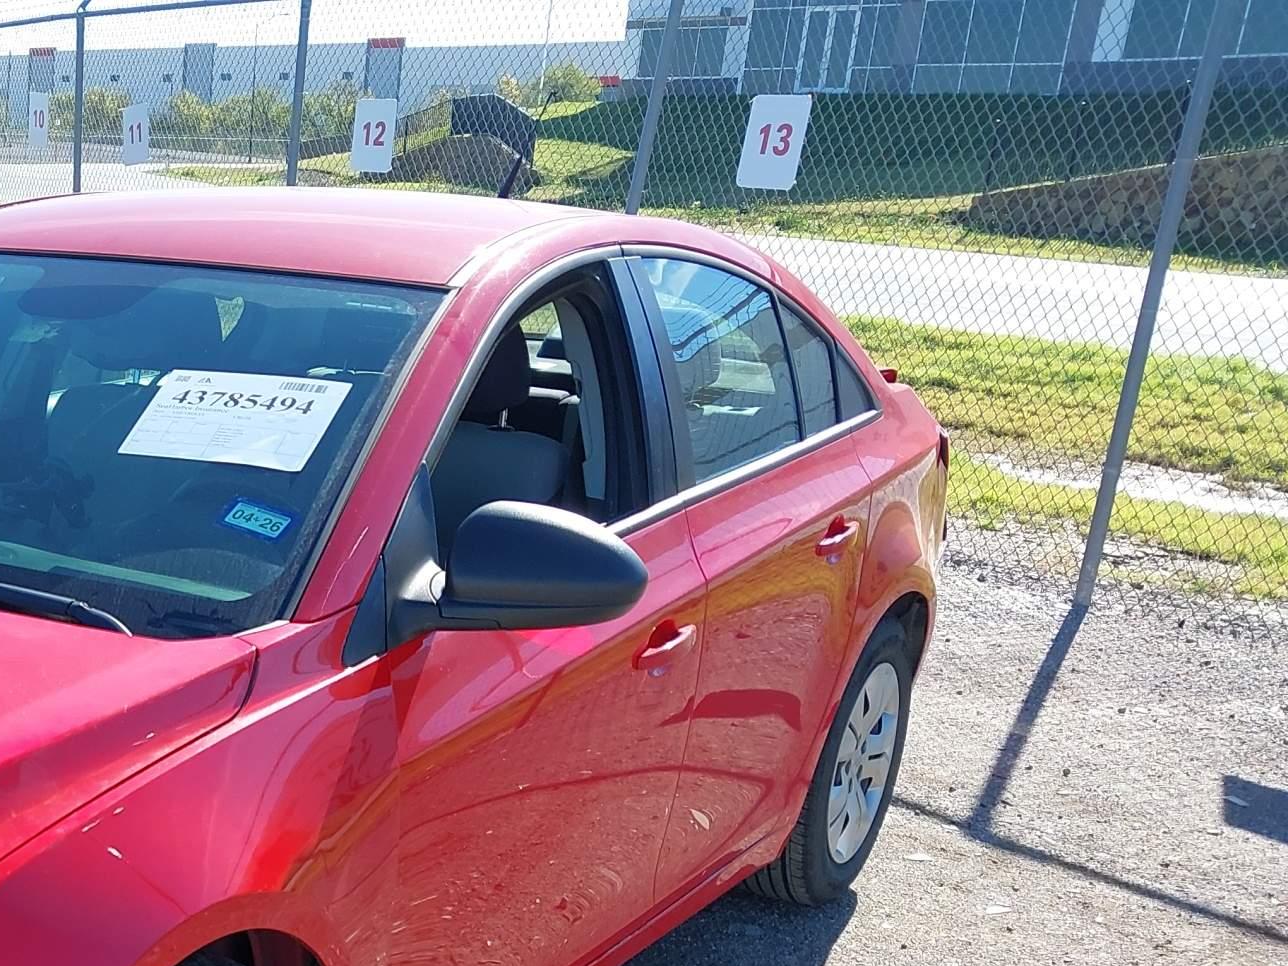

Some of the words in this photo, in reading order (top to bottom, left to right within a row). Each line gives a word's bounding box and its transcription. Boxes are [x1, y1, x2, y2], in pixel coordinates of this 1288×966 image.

[33, 109, 45, 129] 10
[128, 122, 142, 145] 11
[363, 121, 386, 147] 12
[759, 123, 793, 156] 13
[171, 388, 315, 415] 43785494
